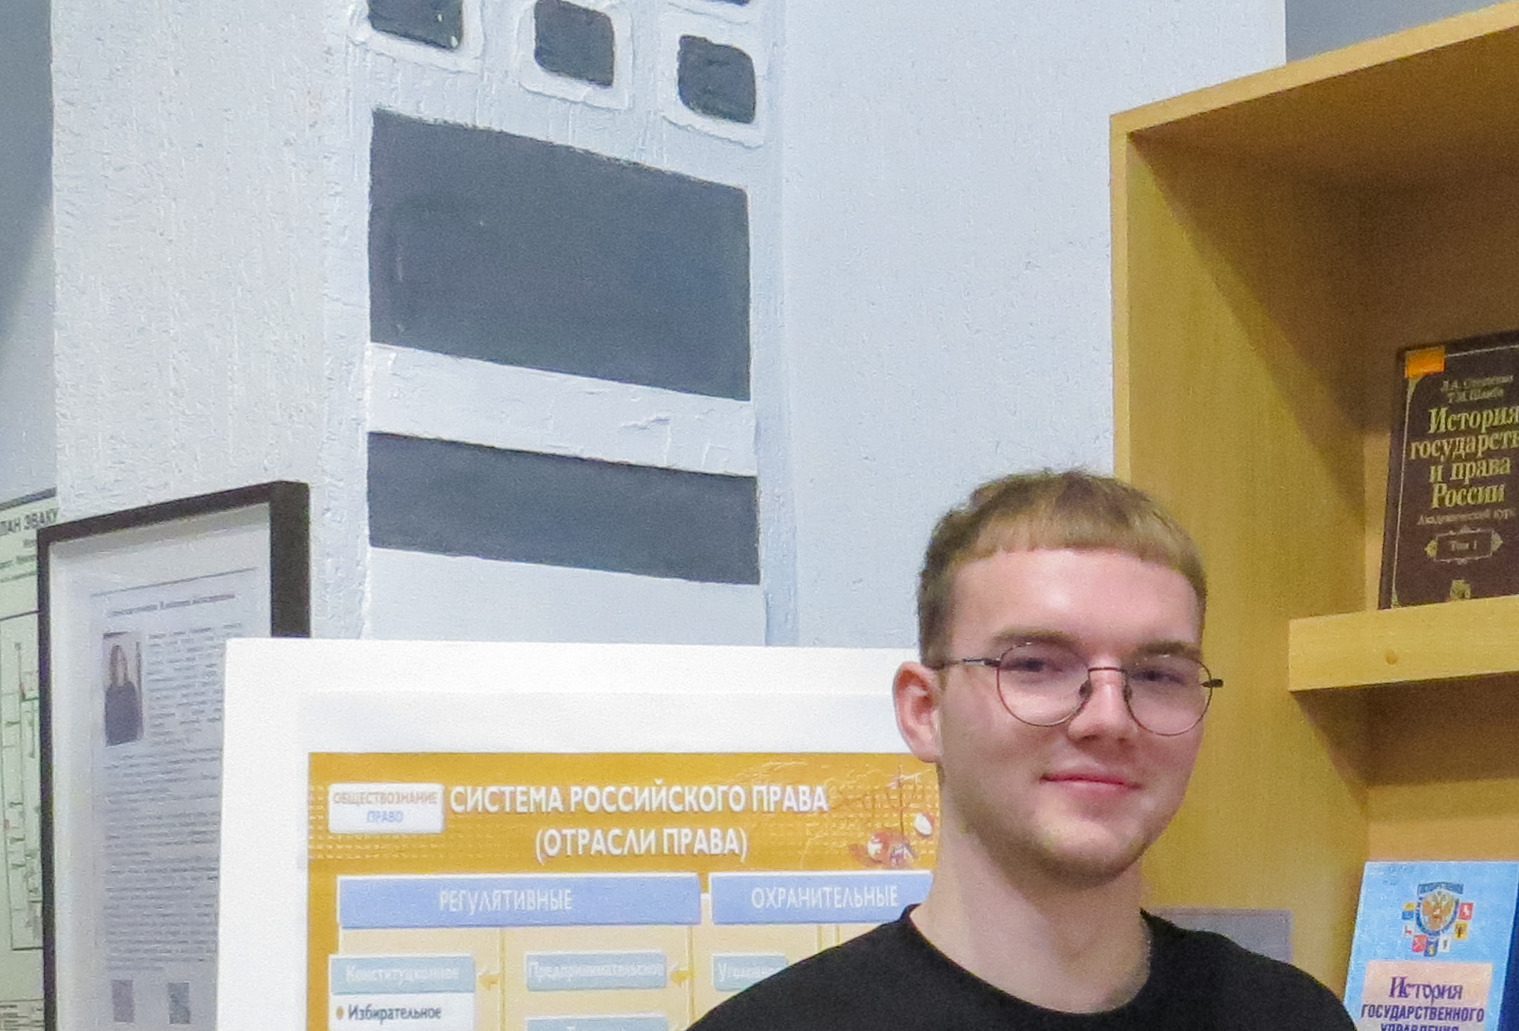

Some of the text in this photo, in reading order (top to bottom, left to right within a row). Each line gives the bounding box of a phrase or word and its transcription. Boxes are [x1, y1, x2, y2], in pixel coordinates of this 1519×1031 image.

[1429, 456, 1512, 484] и права
[1431, 483, 1506, 509] России
[450, 778, 830, 814] СИСТЕМА РОССИЙСКОГО ПРАВА
[366, 810, 404, 824] ПРАВО
[535, 827, 748, 866] (ОТРАСЛИ ПРАВА)
[438, 888, 573, 916] РЕГУЛЯТИВНЫЕ
[751, 885, 899, 910] ОХРАНИТЕЛЬНЫЕ
[1388, 976, 1463, 1004] История
[348, 1003, 442, 1025] Избирательное
[1360, 1004, 1485, 1023] ГОСУДАРСТВЕННОГО
